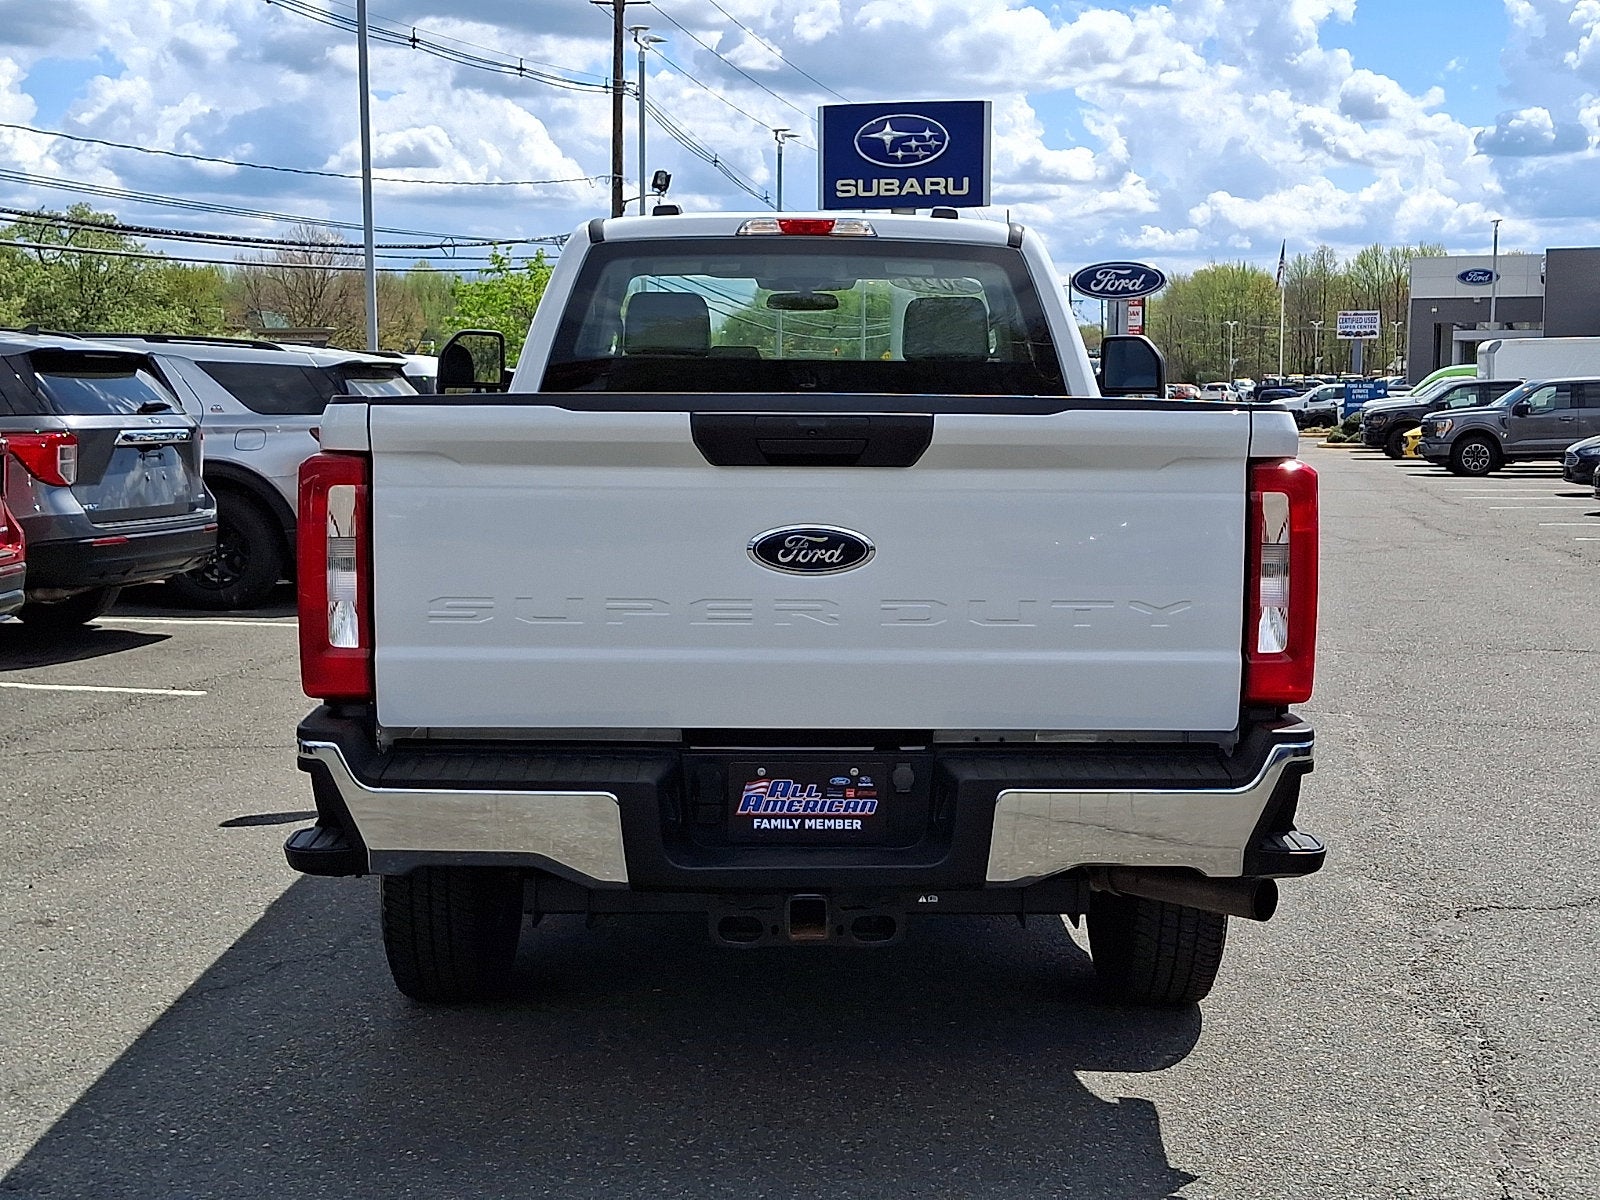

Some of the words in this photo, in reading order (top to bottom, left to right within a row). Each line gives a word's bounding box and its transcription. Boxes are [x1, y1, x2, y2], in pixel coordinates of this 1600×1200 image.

[836, 177, 969, 197] SUBARU
[1090, 268, 1146, 291] Ford
[1466, 271, 1490, 281] Ford
[777, 535, 846, 563] Ford
[428, 596, 840, 627] SUPER
[880, 599, 1192, 627] DUTY
[767, 779, 822, 798] ALL
[739, 793, 878, 814] AMERICAN
[753, 819, 800, 830] FAMILY
[804, 819, 862, 830] MEMBER
